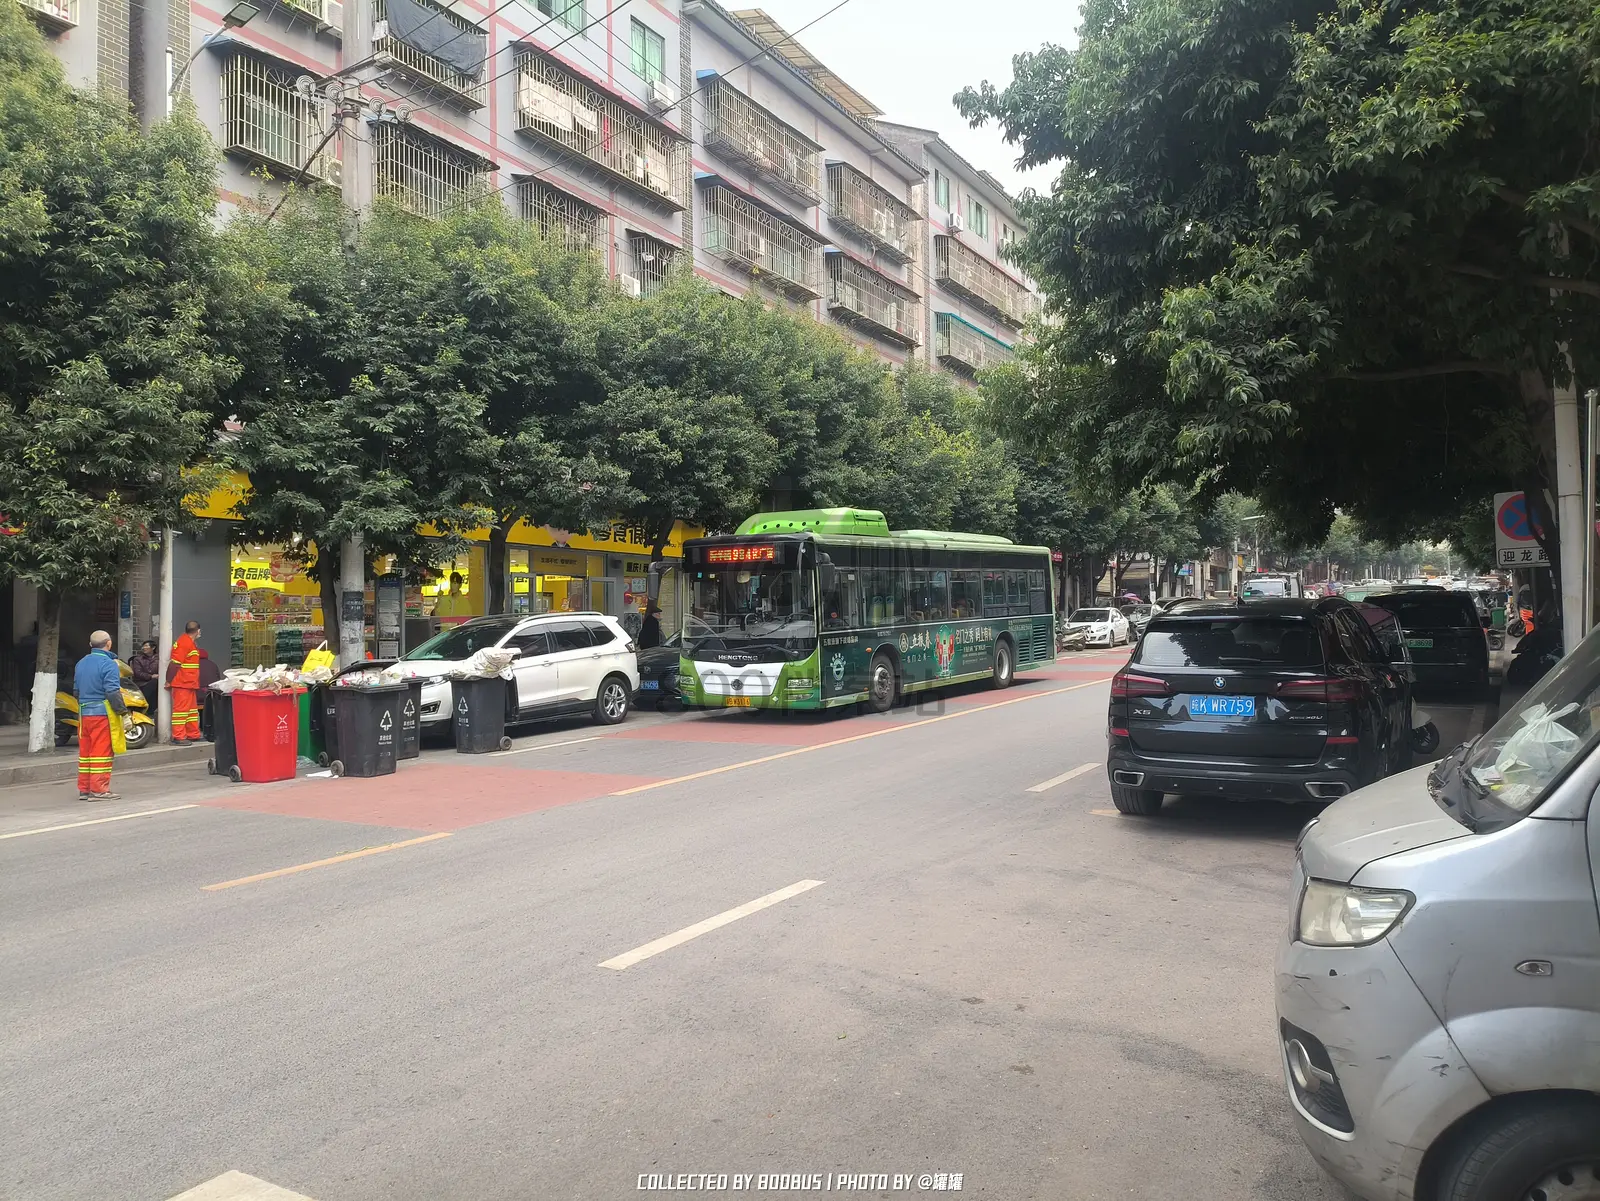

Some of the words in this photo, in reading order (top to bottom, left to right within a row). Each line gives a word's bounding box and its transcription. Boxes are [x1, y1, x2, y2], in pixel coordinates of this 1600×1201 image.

[1503, 549, 1549, 562] 迎龙路
[231, 566, 270, 580] 食品牌
